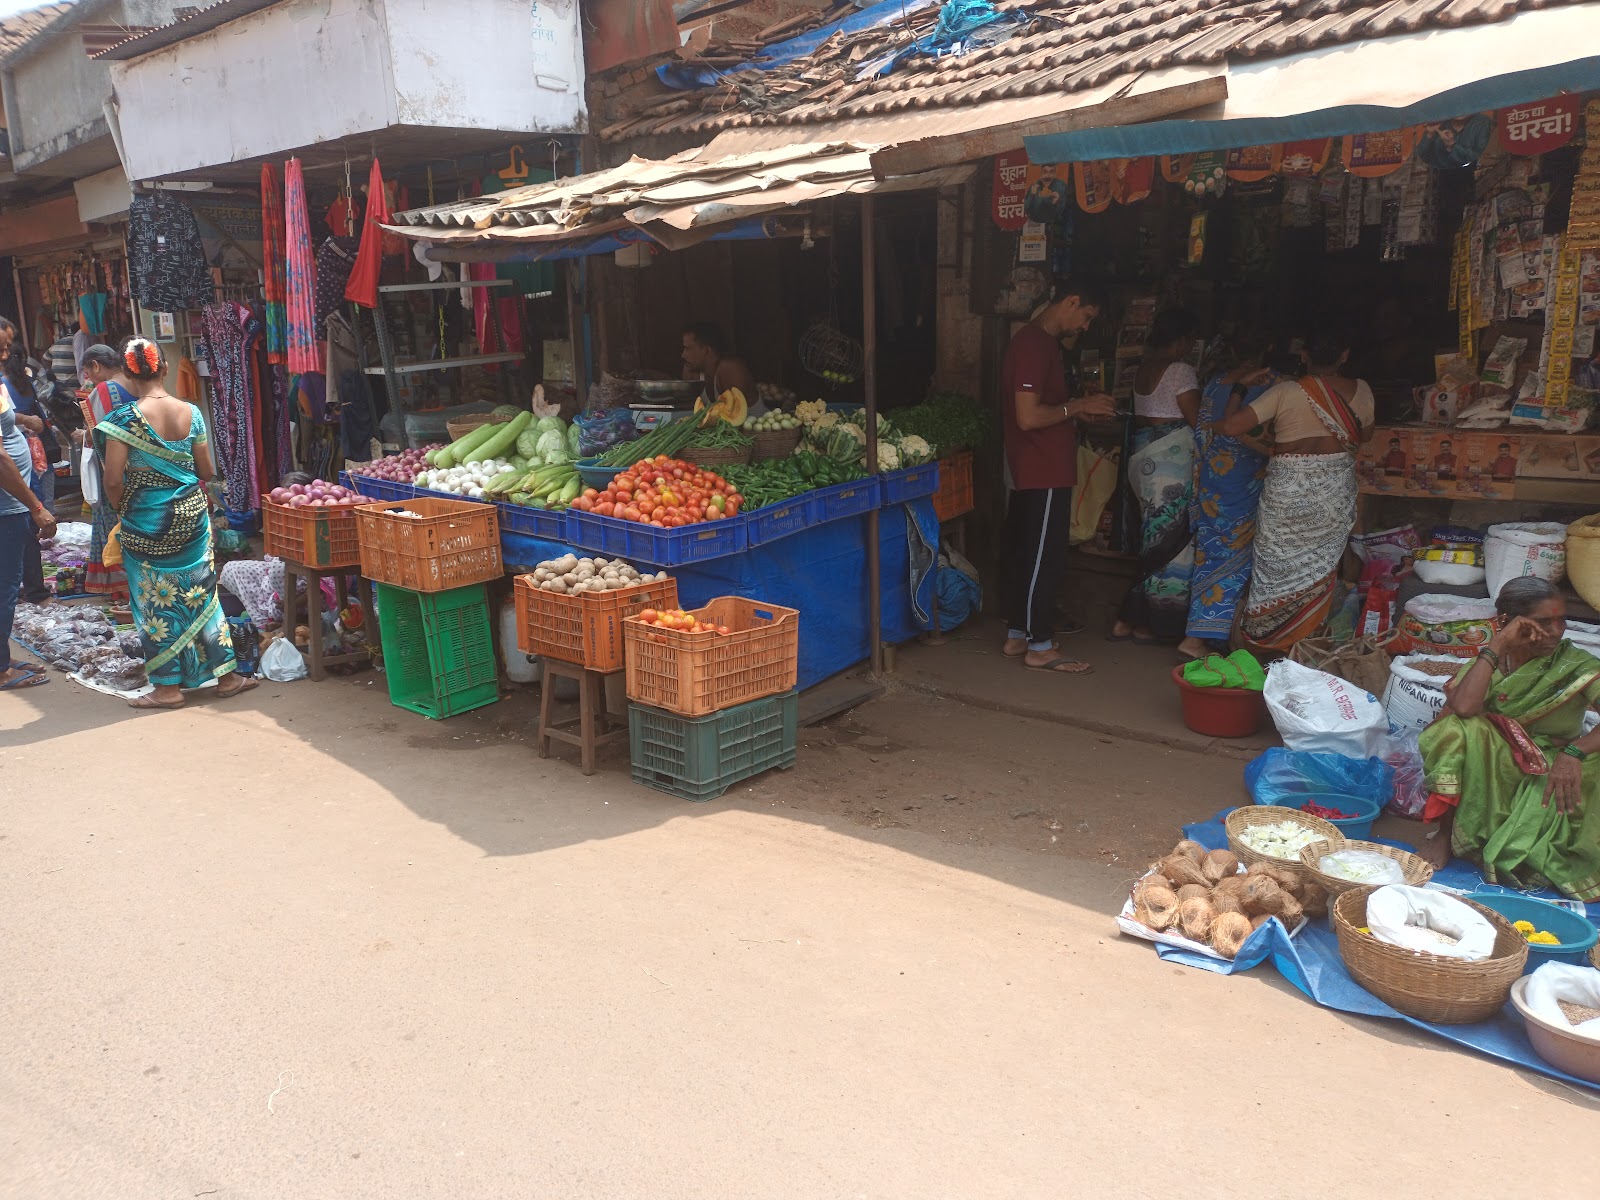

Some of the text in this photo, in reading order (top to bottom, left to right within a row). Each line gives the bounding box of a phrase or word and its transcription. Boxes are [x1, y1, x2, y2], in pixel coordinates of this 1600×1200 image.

[1506, 108, 1530, 124] होऊ
[1506, 107, 1572, 141] घरचं!
[1398, 678, 1427, 704] NIPANI
